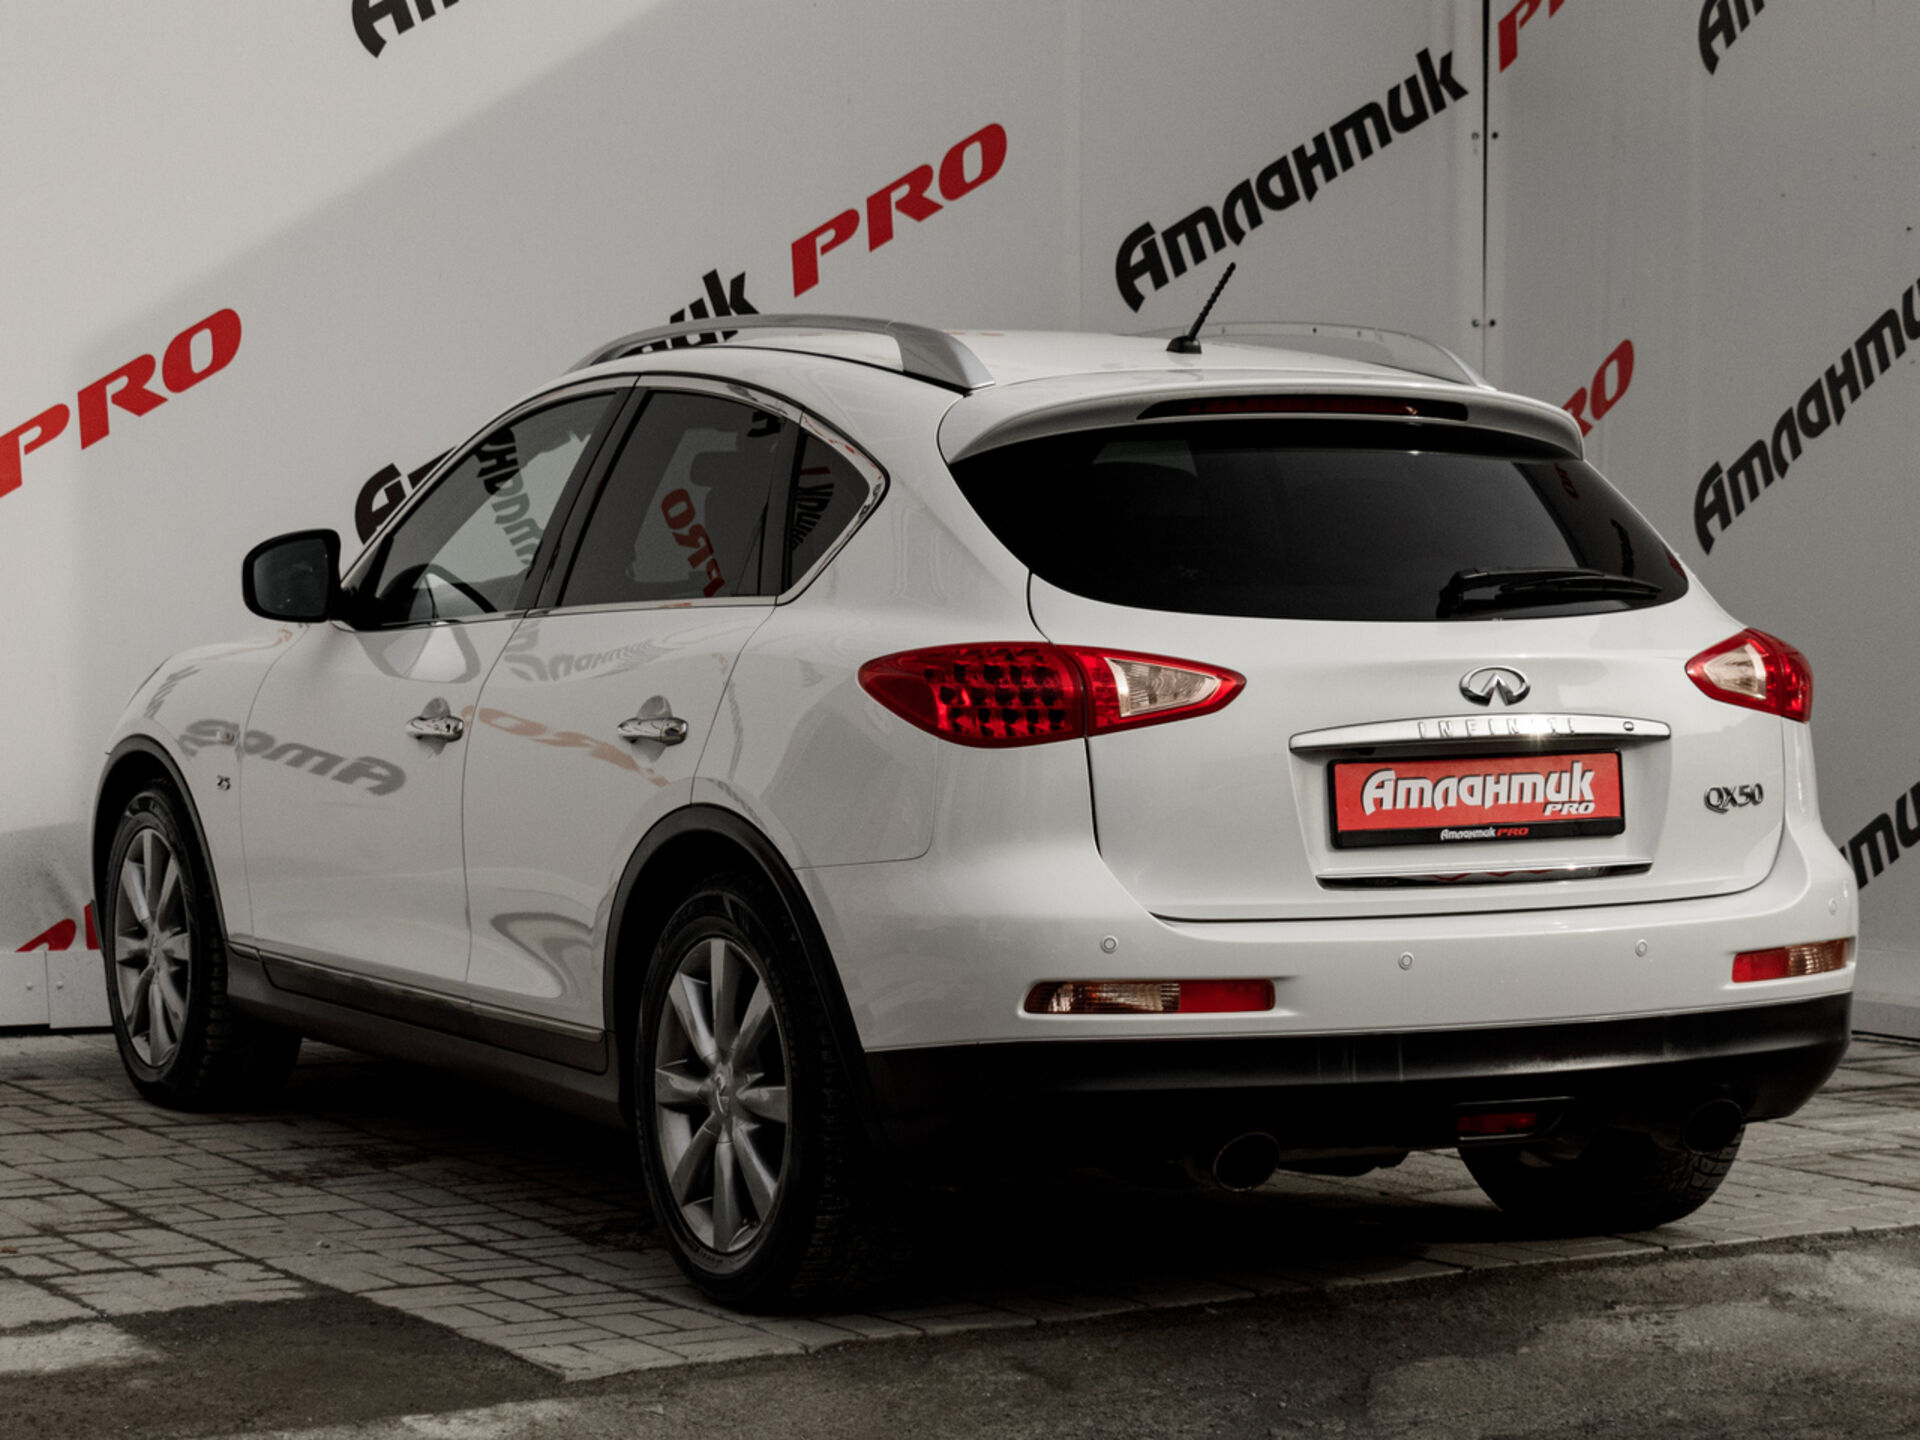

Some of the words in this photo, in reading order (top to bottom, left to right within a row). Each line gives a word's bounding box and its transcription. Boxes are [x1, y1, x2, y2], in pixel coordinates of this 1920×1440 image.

[791, 122, 1008, 298] PRO
[0, 308, 243, 499] PRO
[1562, 339, 1634, 438] RO
[1693, 277, 1920, 556] Атланти
[1416, 718, 1576, 738] INFINTI
[1543, 800, 1595, 816] PRO
[1703, 782, 1764, 814] QX50
[1496, 827, 1529, 837] PRO
